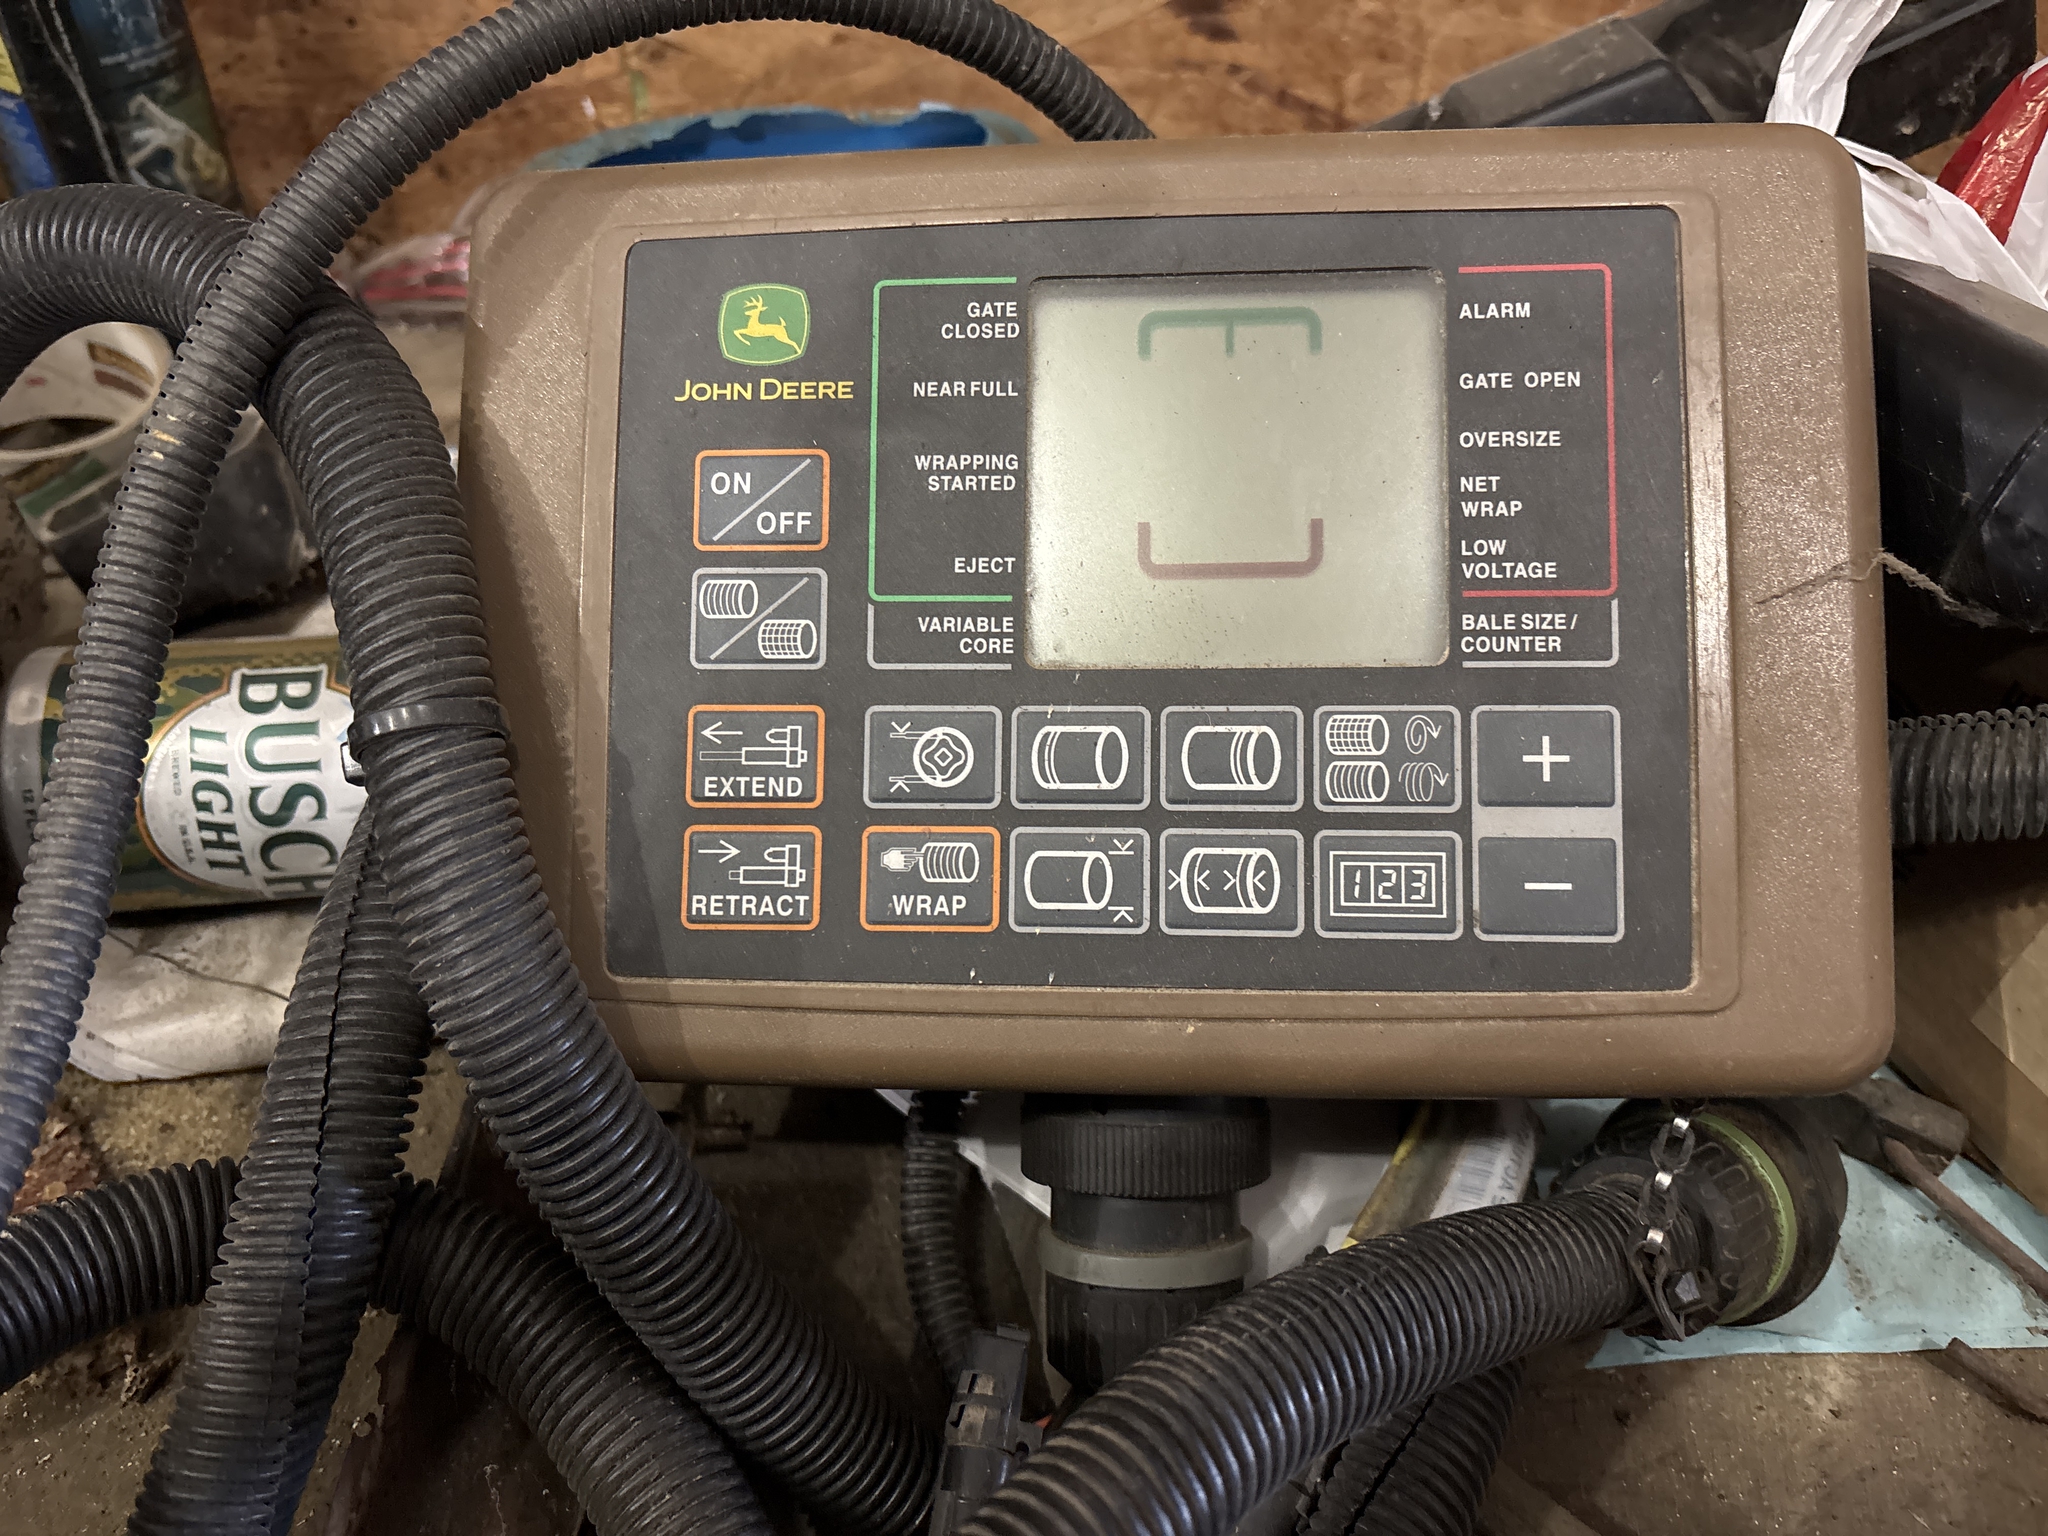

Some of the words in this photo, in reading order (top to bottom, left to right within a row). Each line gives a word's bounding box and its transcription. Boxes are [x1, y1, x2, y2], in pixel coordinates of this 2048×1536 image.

[966, 301, 1018, 318] GATE
[1459, 302, 1531, 320] ALARM
[941, 322, 1020, 340] CLOSED
[913, 381, 966, 398] NEAR
[970, 380, 1019, 397] FULL
[1459, 372, 1513, 390] GATE
[1524, 371, 1581, 388] OPEN
[674, 379, 753, 402] JOHN
[759, 378, 855, 401] DEERE
[1459, 430, 1562, 448] OVERSIZE
[914, 453, 1019, 471] WRAPPING
[710, 471, 751, 495] ON
[928, 474, 1016, 492] STARTED
[1460, 475, 1501, 493] NET
[1460, 500, 1523, 518] WRAP
[756, 511, 812, 535] OFF
[1461, 539, 1507, 556] LOW
[954, 557, 1016, 574] EJECT
[1461, 561, 1558, 579] VOLTAGE
[917, 616, 1014, 633] VARIABLE
[1462, 613, 1516, 631] BALE
[959, 637, 1014, 654] CORE
[1460, 635, 1562, 653] COUNTER
[238, 670, 340, 898] BUSCH
[704, 776, 803, 797] EXTEND
[189, 726, 250, 876] LIGHT
[691, 894, 810, 917] RETRACT
[892, 894, 967, 916] WRAP
